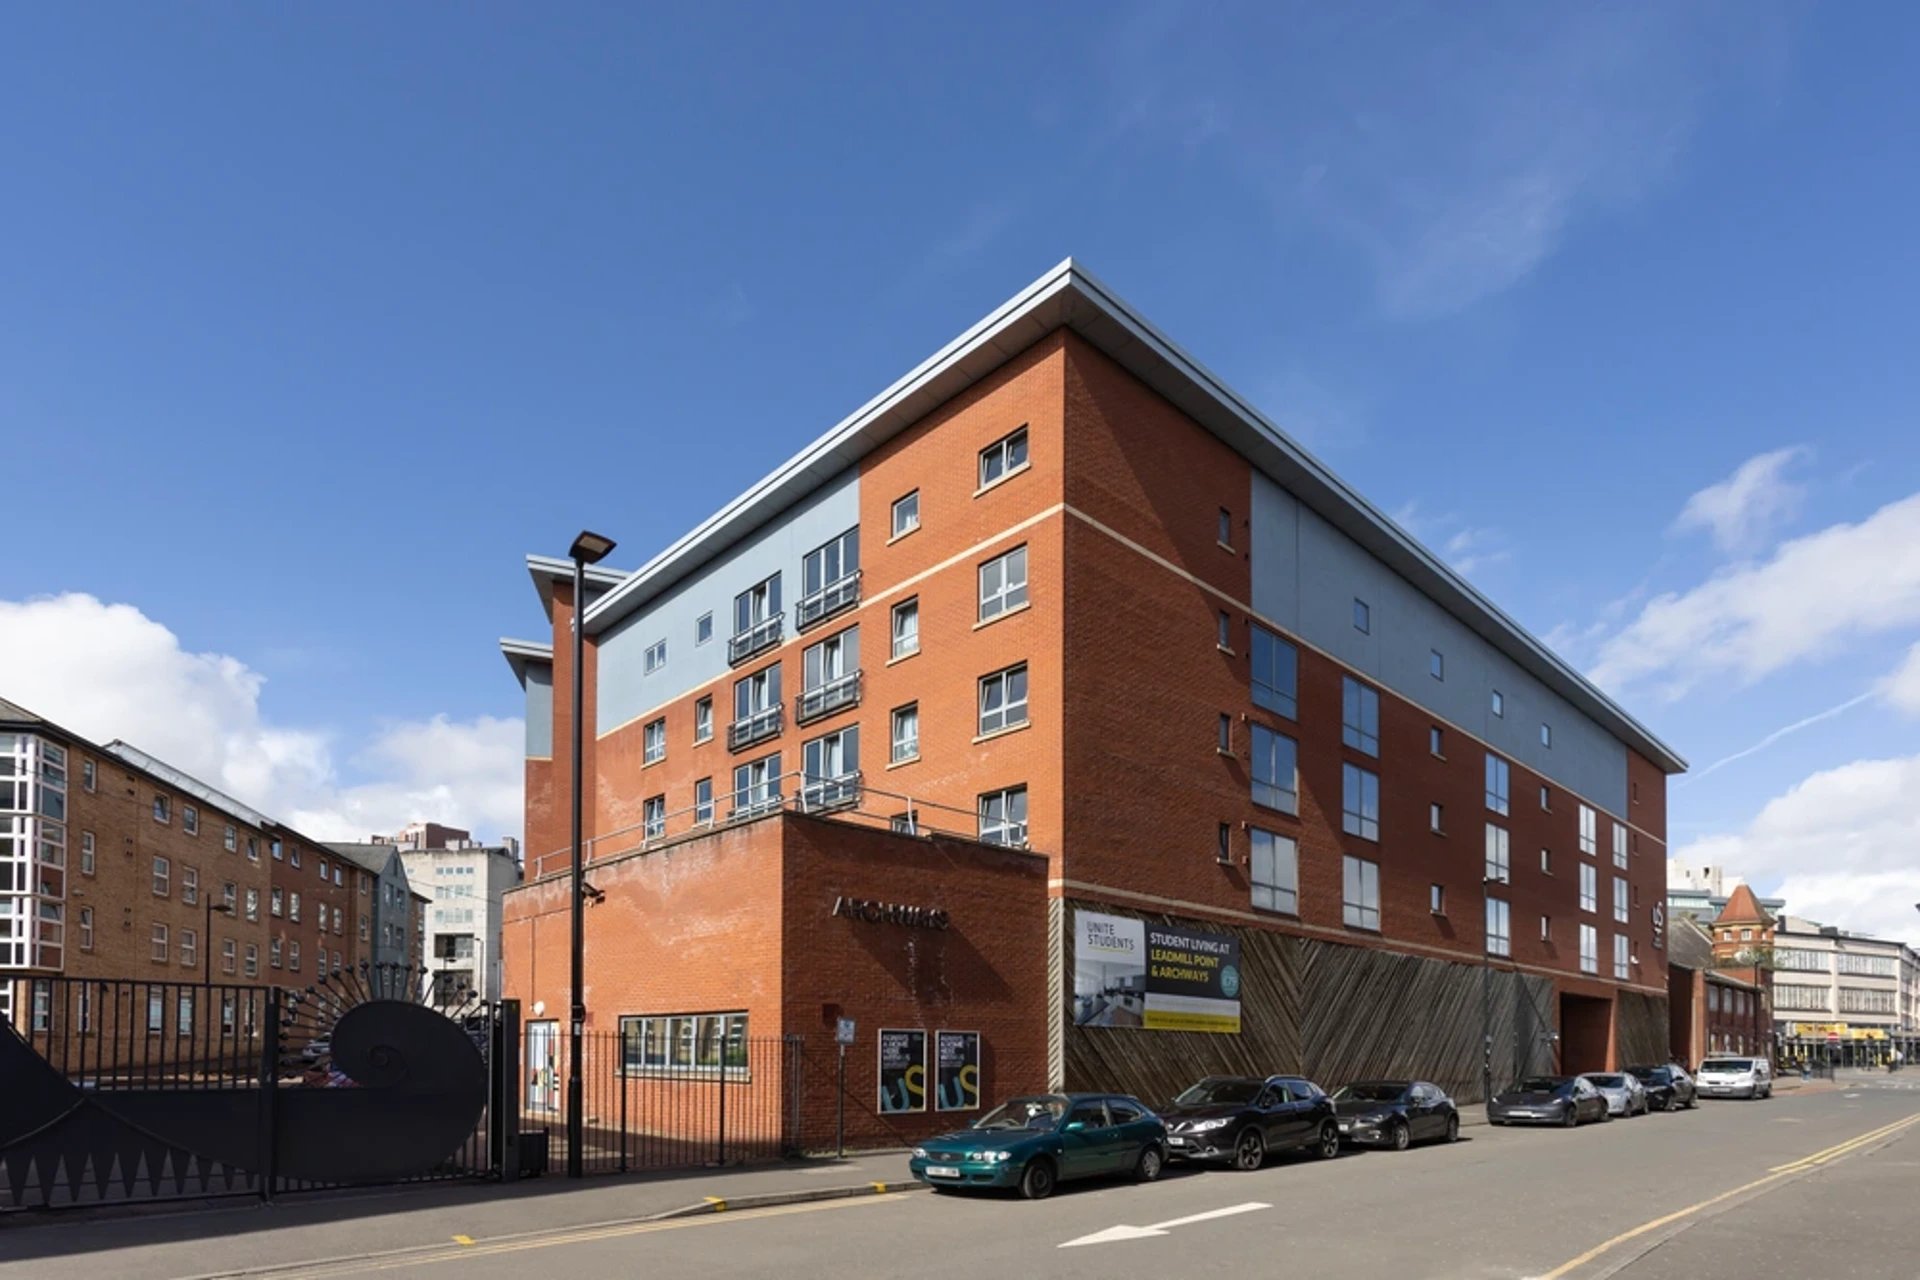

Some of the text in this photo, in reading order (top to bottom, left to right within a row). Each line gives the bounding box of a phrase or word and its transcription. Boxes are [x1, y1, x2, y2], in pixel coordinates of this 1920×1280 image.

[1087, 922, 1114, 935] UNITE
[1088, 935, 1134, 950] STUDENTS
[1150, 932, 1230, 955] STUDENT LIVING AT
[1151, 949, 1219, 968] LEADMILL POINT
[1151, 965, 1158, 977] &
[1160, 966, 1209, 983] ARCHWAYS
